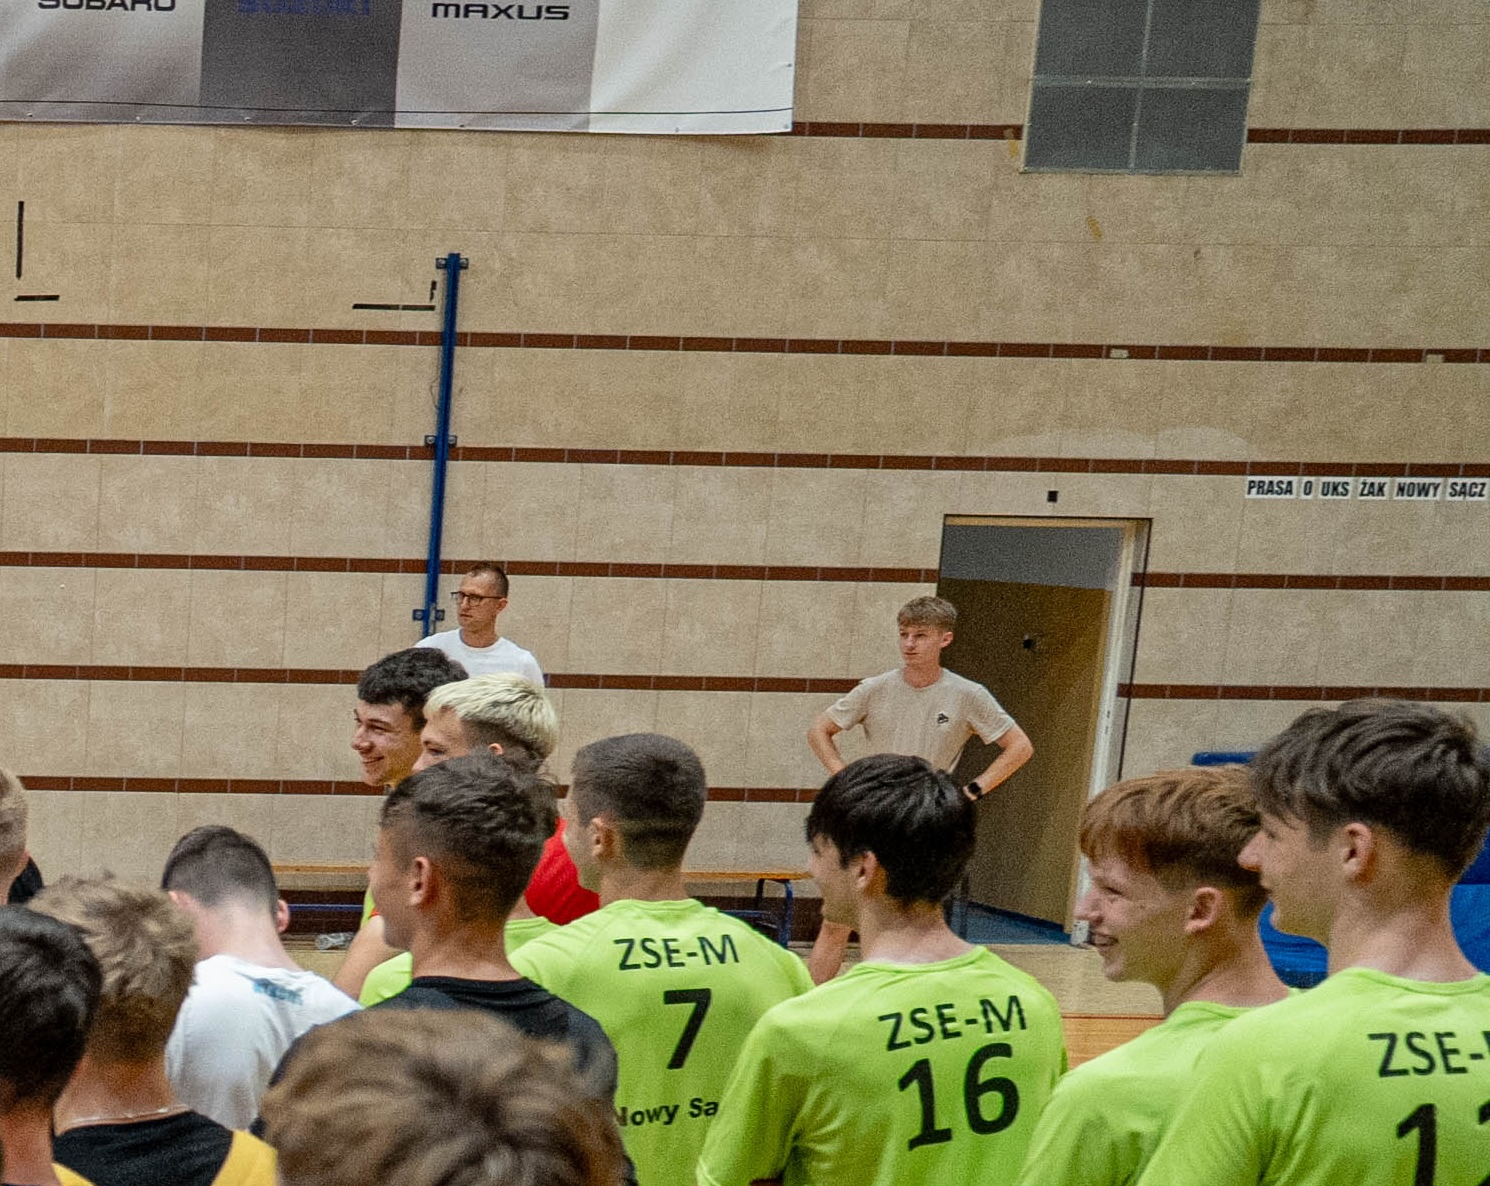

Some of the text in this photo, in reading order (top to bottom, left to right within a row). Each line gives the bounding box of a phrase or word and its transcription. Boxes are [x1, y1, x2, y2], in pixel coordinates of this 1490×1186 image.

[431, 2, 570, 21] MAXUS
[1247, 480, 1294, 496] PRASA
[1303, 480, 1313, 496] O
[1321, 481, 1350, 497] UKS
[1359, 479, 1387, 498] ŻAK
[1396, 482, 1441, 498] NOWY
[614, 934, 740, 971] ZSE-M
[663, 987, 712, 1070] 7
[878, 995, 1028, 1052] ZSE-M
[1367, 1030, 1490, 1078] ZSE-
[897, 1042, 1021, 1152] 16
